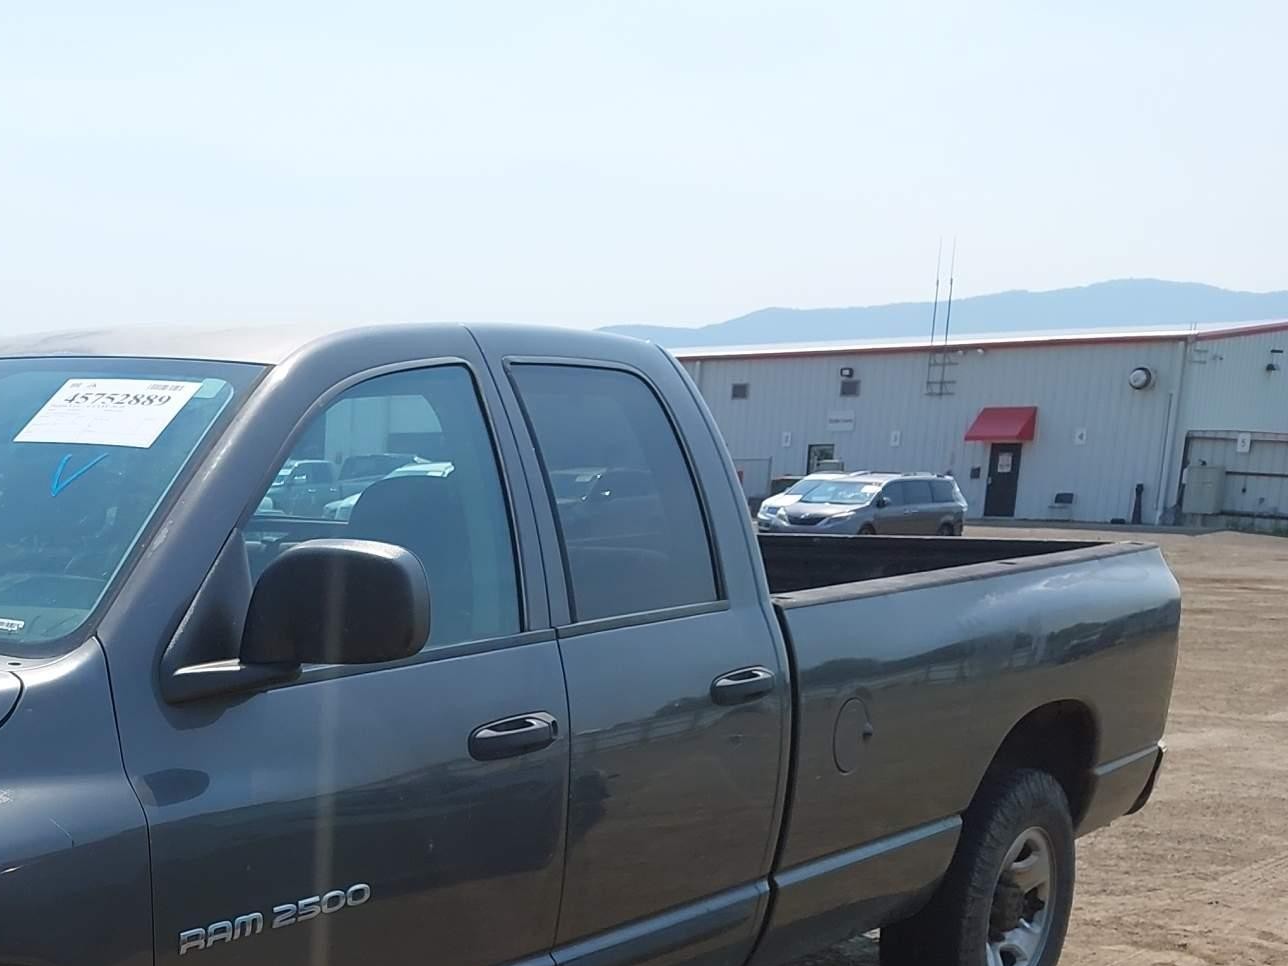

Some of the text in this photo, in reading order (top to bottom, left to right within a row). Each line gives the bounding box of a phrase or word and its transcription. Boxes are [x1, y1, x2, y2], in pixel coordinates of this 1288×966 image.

[64, 392, 172, 407] 45752889
[179, 883, 371, 956] RAM 2500
